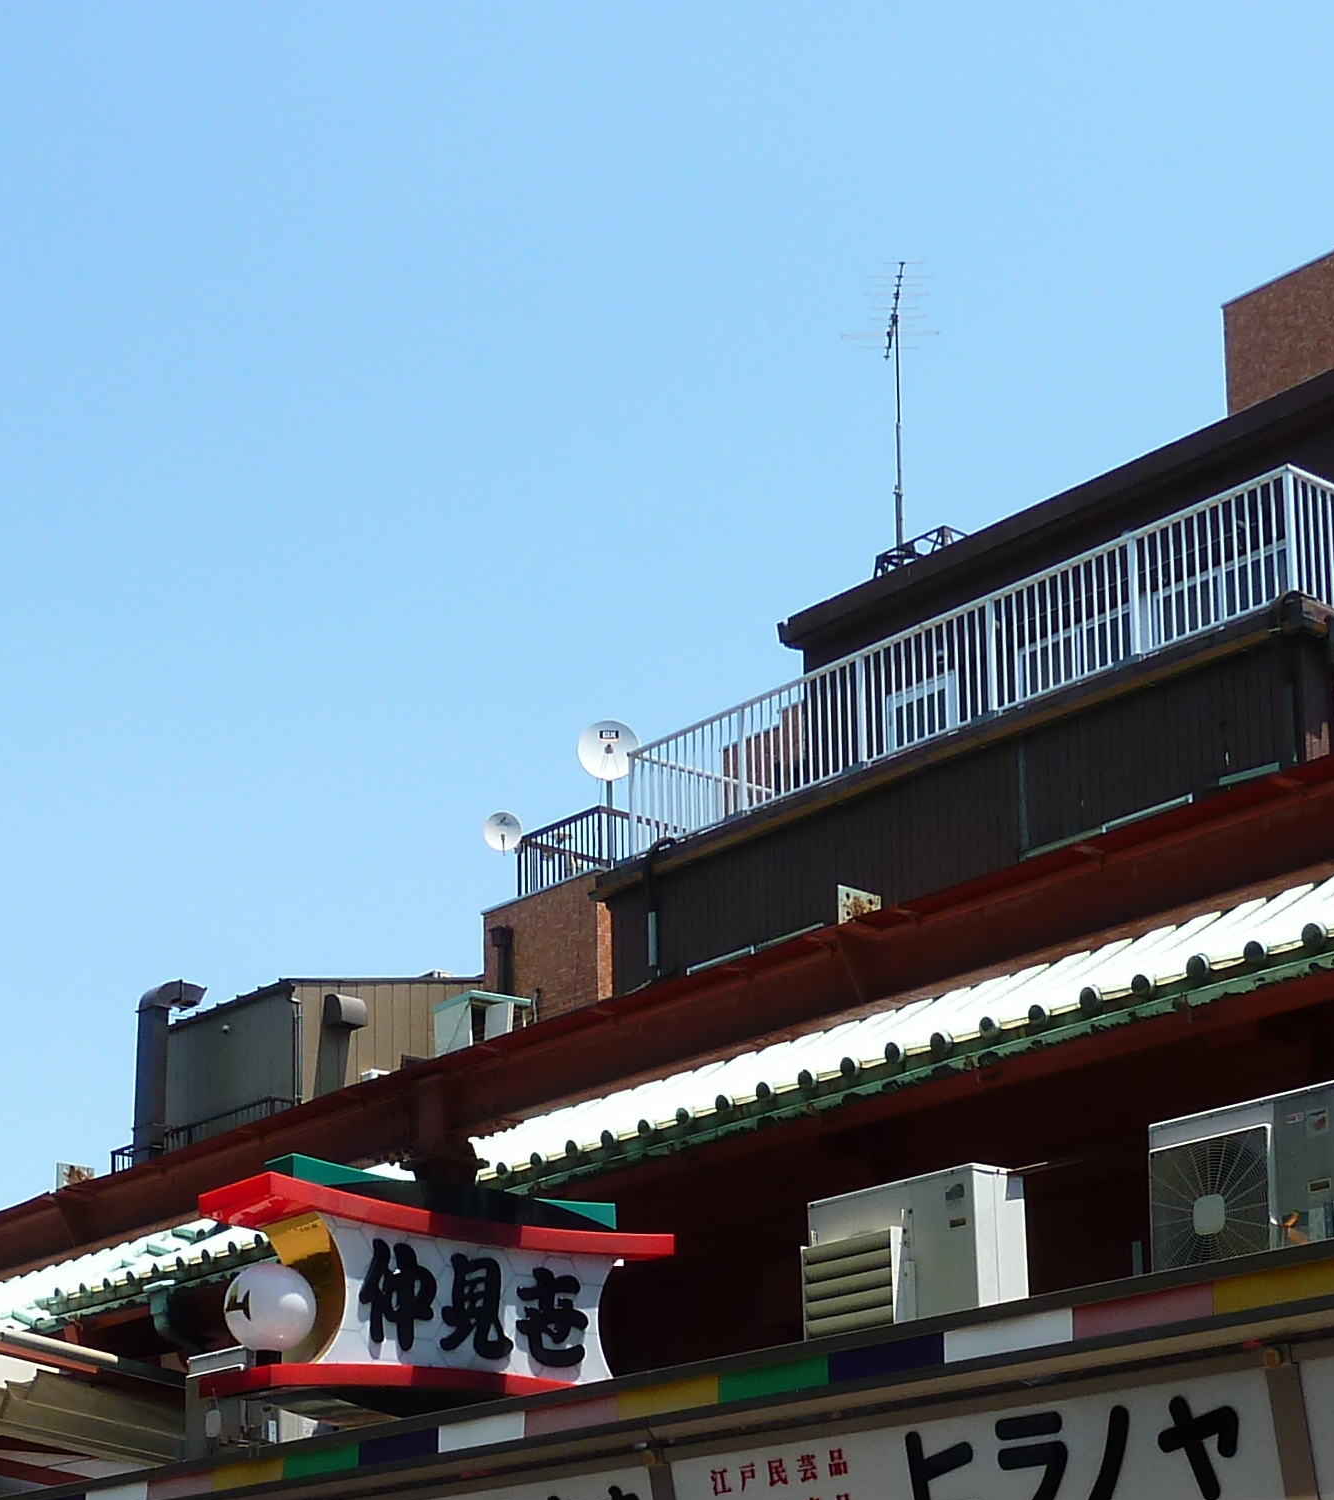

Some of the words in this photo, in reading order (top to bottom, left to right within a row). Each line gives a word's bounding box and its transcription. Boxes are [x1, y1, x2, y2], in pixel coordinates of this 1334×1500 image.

[359, 1238, 589, 1367] 仲見世
[710, 1447, 849, 1497] 江戸民芸品
